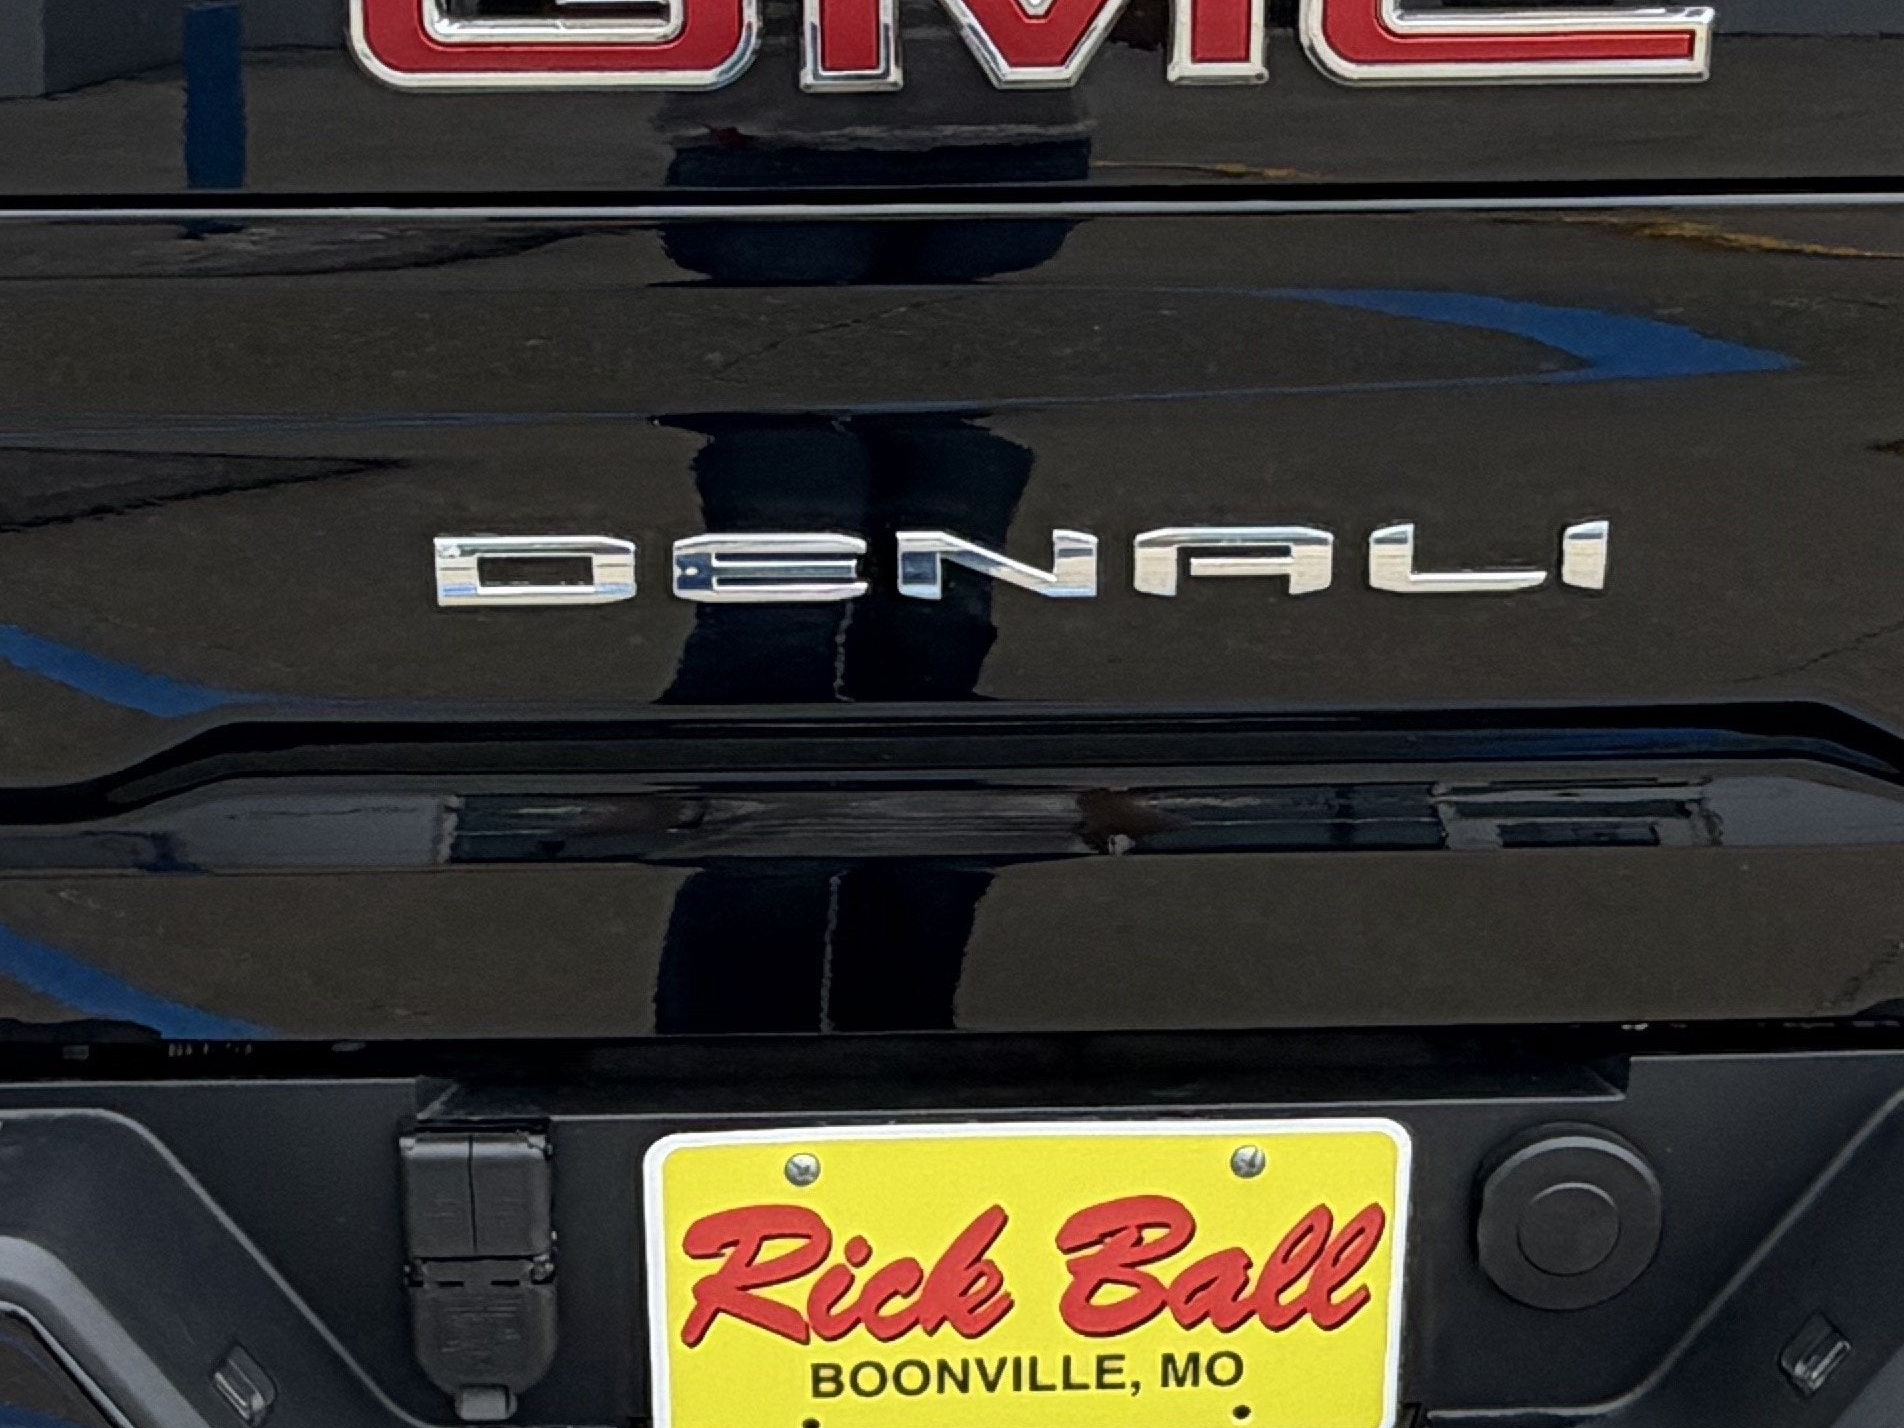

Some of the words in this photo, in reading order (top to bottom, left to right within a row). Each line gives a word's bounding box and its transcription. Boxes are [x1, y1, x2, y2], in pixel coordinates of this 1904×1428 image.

[434, 520, 1610, 605] DENALI
[681, 1203, 1015, 1347] Rick
[1055, 1195, 1386, 1339] Ball
[810, 1354, 1141, 1399] BOONVILLE,
[1160, 1350, 1244, 1388] MO
